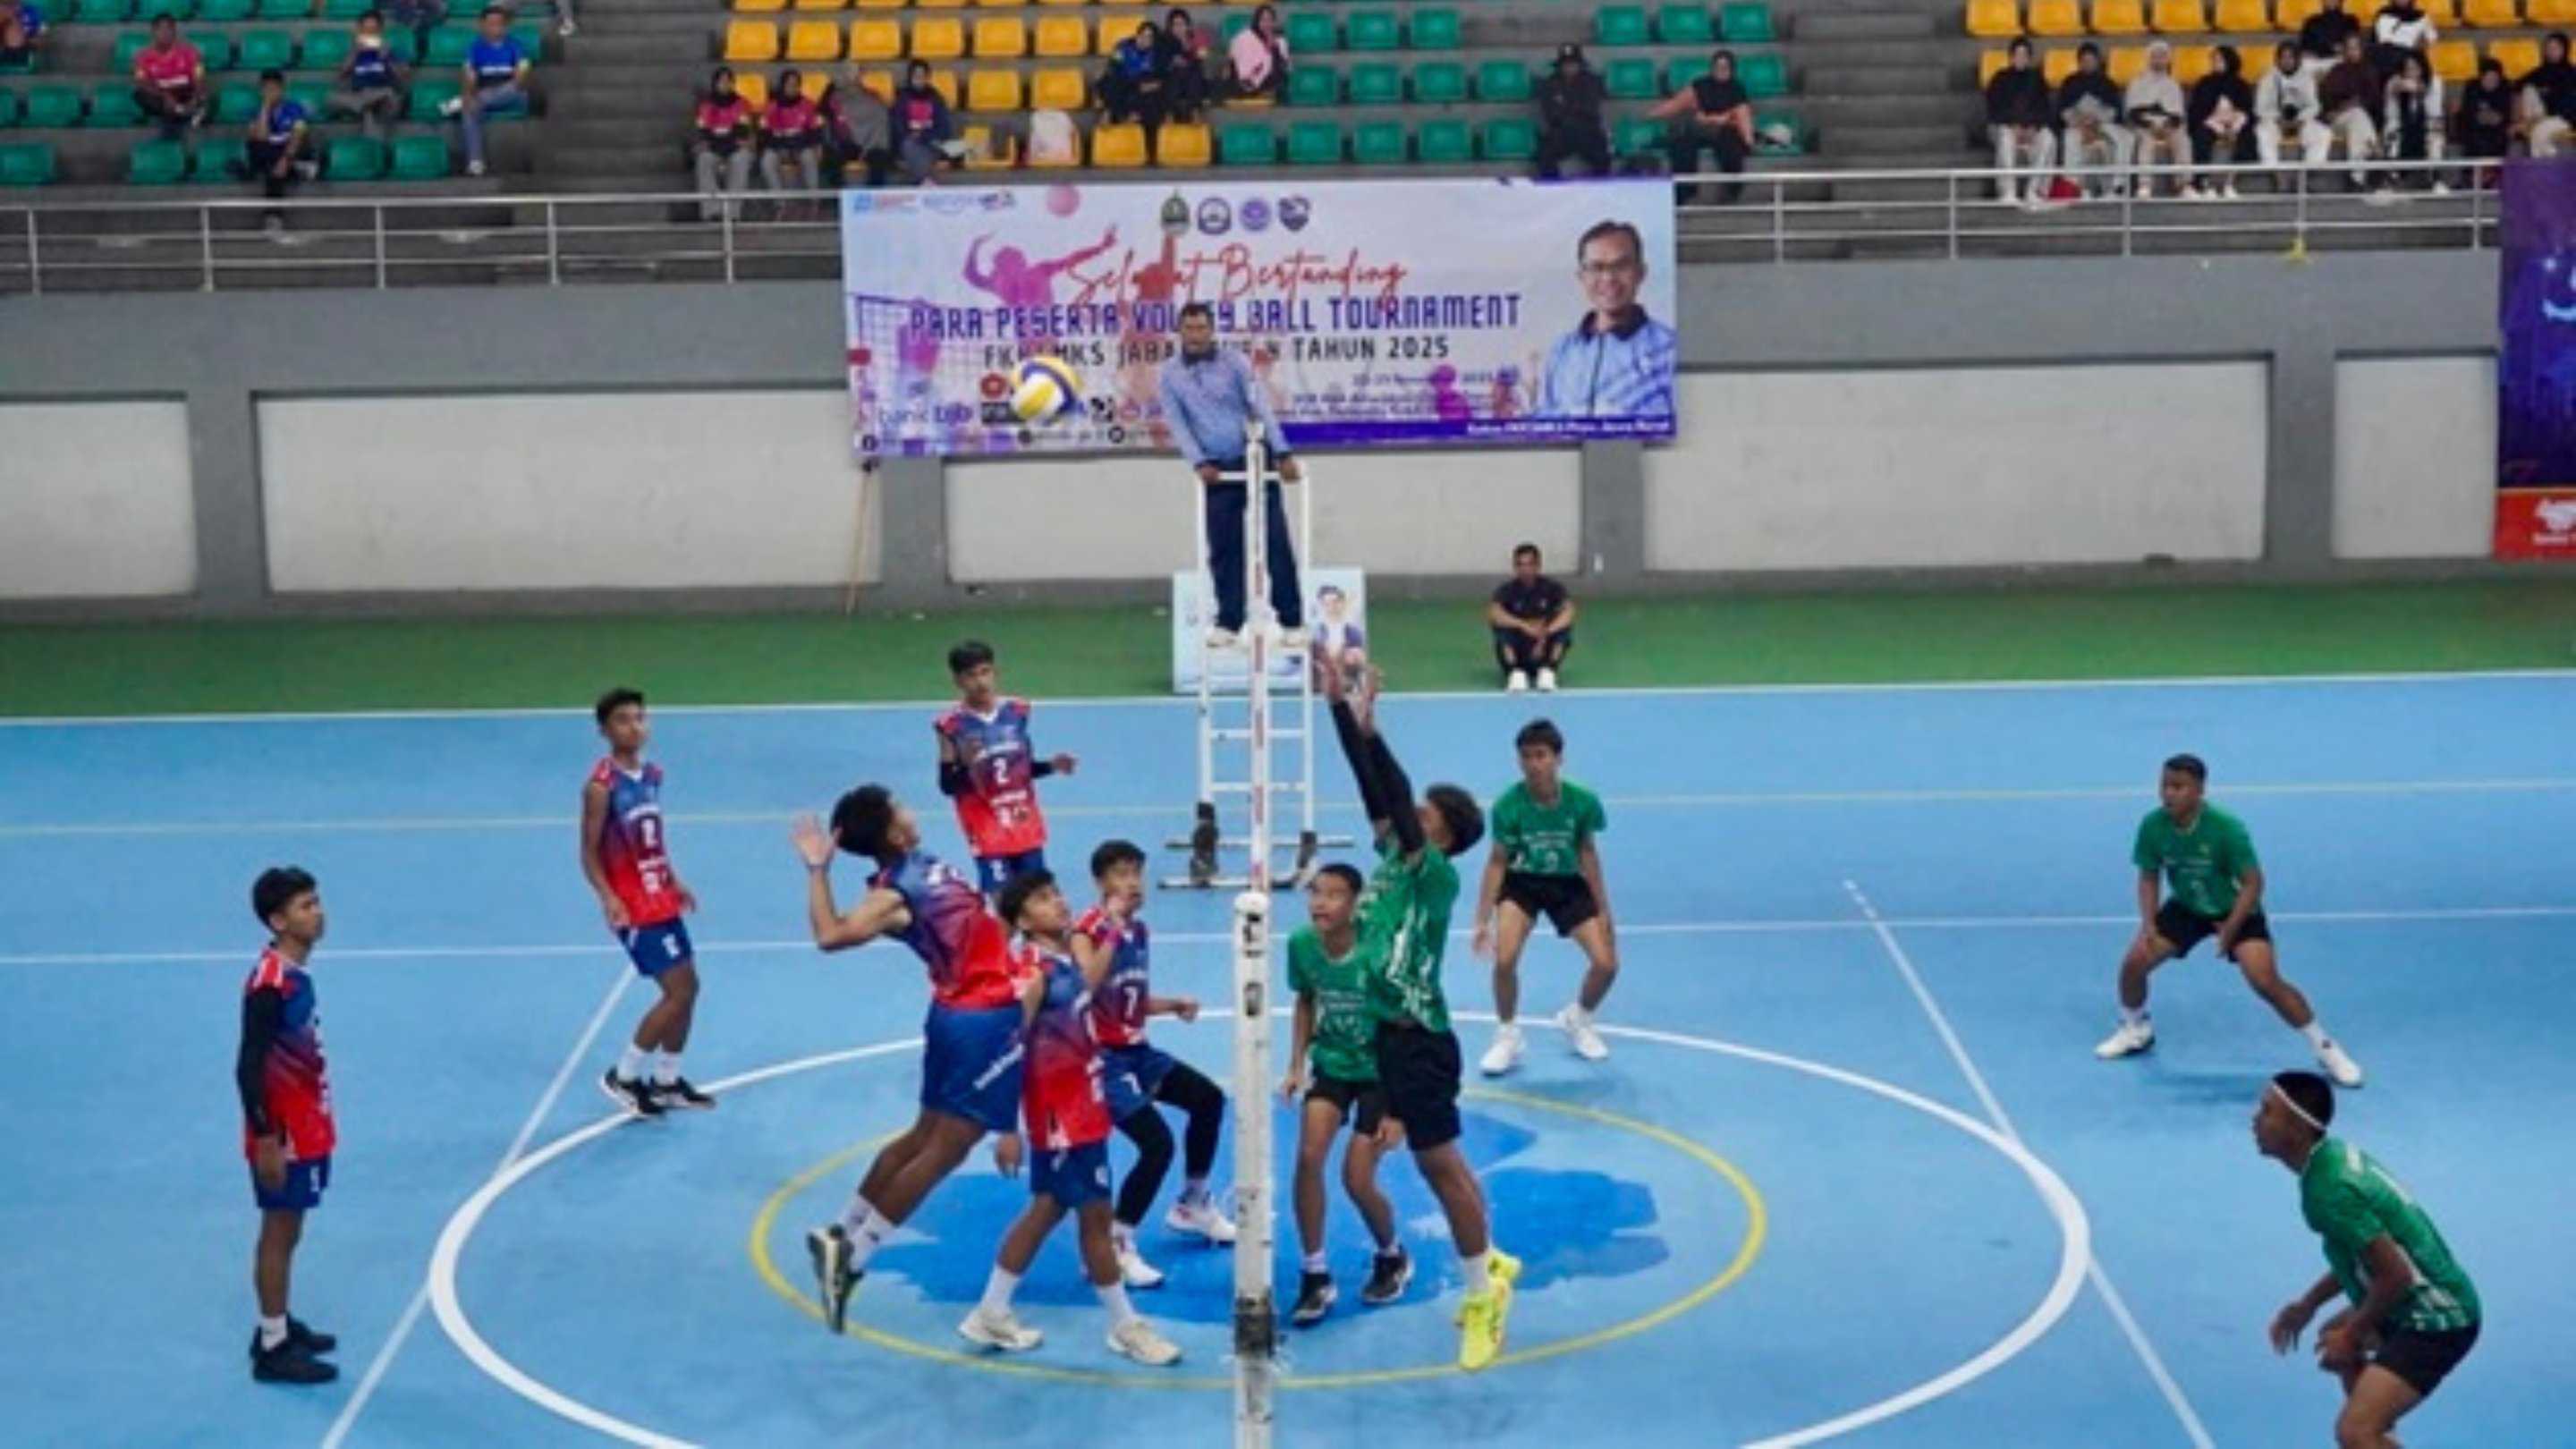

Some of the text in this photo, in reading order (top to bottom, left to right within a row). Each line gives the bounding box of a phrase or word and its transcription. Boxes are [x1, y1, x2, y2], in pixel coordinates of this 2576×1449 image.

[910, 307, 982, 339] PARA
[996, 302, 1120, 339] PESERTA
[1247, 298, 1318, 332] BALL
[1327, 292, 1522, 331] TOURNAMENT
[1293, 335, 1377, 362] TAHUN
[1389, 334, 1450, 360] 2025
[1123, 985, 1139, 1021] 7
